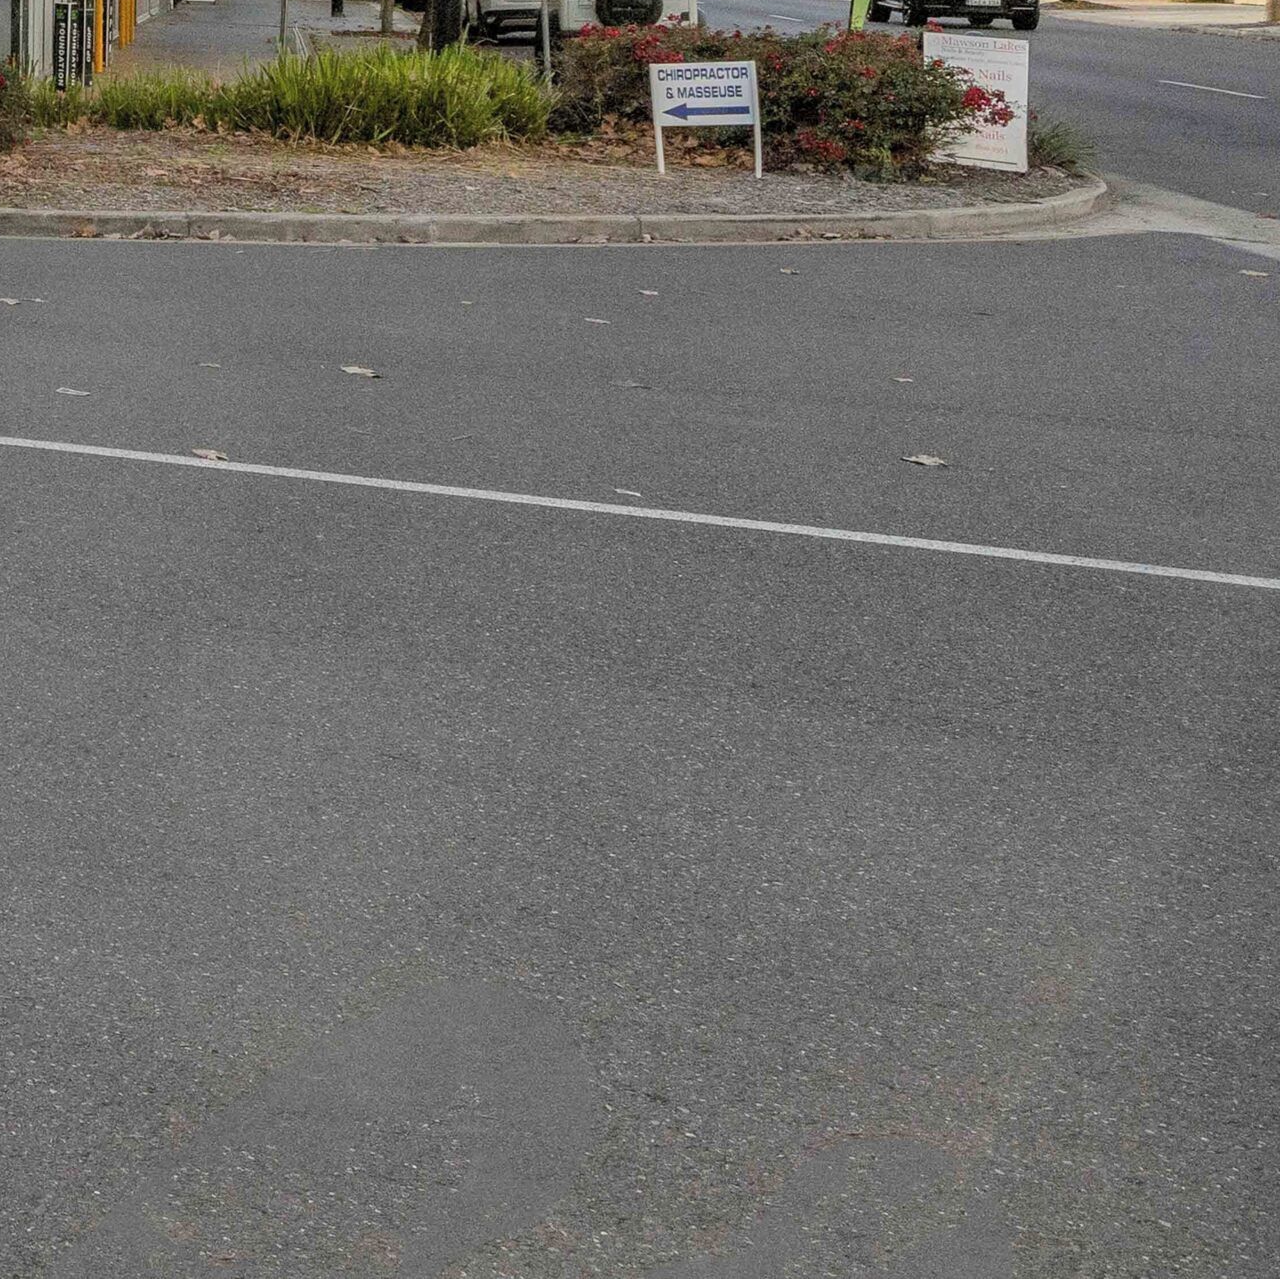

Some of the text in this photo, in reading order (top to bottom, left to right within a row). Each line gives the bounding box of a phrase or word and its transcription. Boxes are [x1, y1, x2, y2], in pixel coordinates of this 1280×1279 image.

[941, 36, 1027, 52] Mawson Lakes
[57, 22, 66, 87] FOUNDATION
[70, 22, 78, 86] FOUNDATION
[657, 67, 749, 81] CHIROPRACTOR
[978, 68, 1013, 82] Nails
[665, 85, 743, 99] & MASSEUSE
